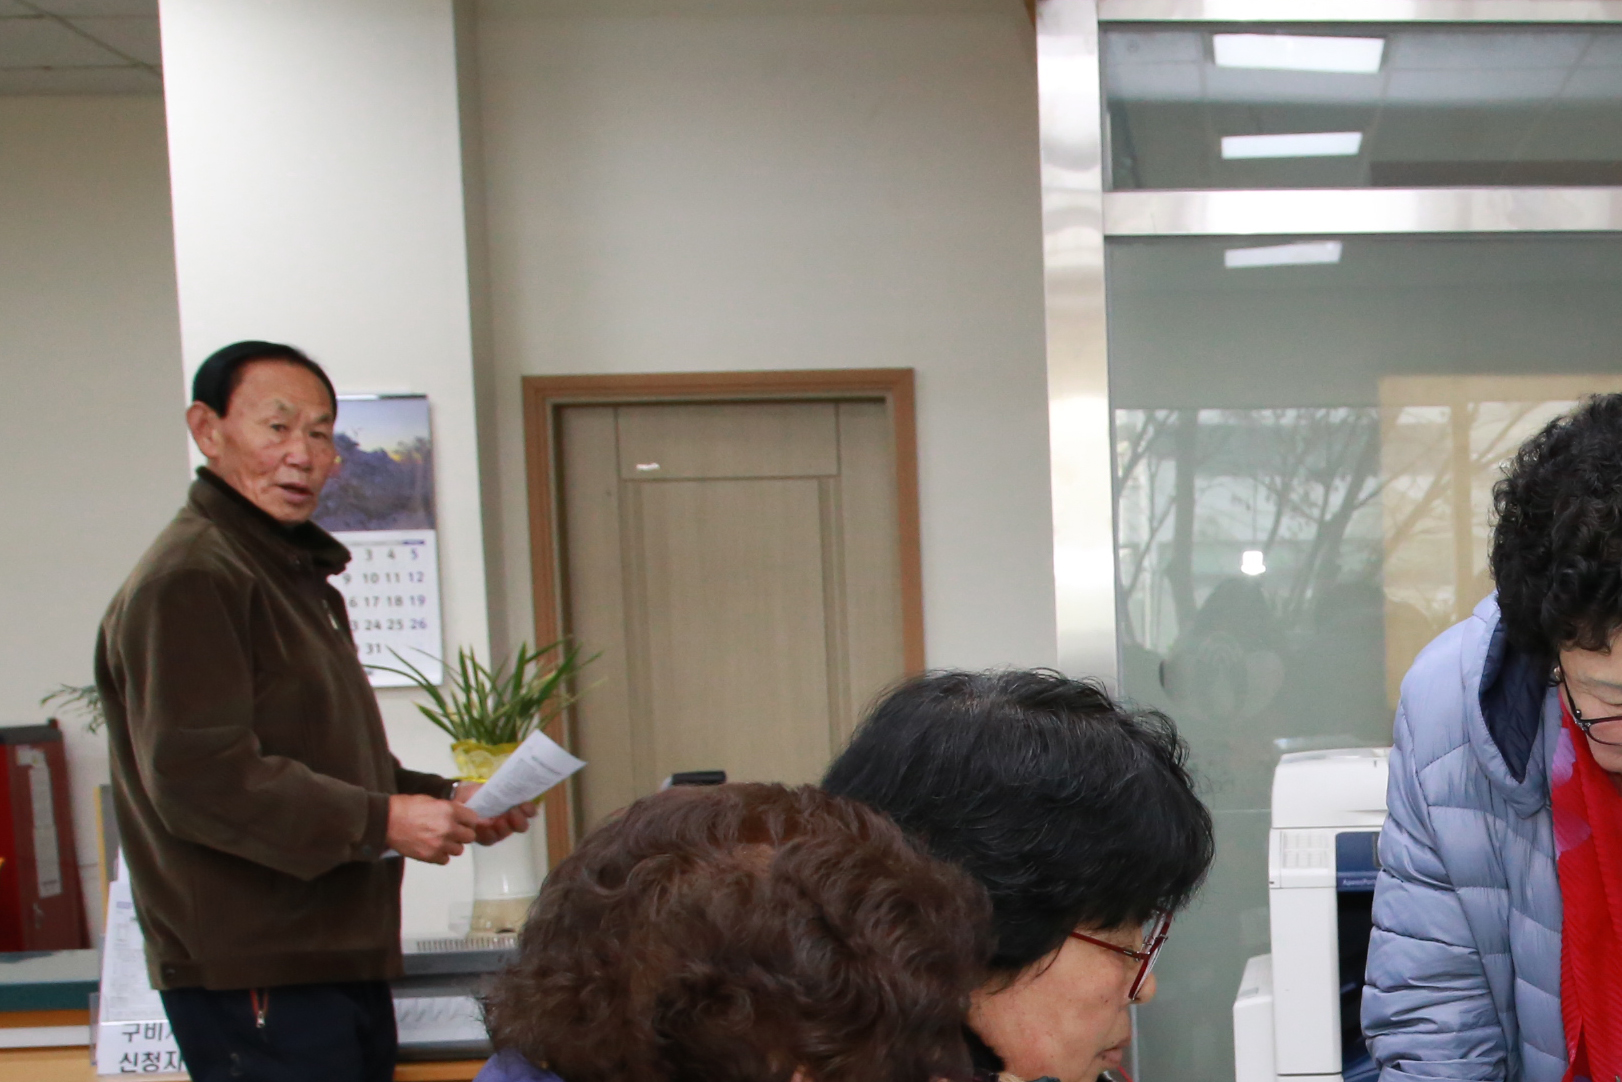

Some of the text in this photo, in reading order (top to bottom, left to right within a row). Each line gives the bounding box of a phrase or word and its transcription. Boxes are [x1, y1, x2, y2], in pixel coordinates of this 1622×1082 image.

[386, 549, 395, 560] 4
[411, 549, 419, 560] 5
[363, 573, 379, 584] 10
[385, 572, 400, 583] 11
[408, 571, 424, 583] 12
[364, 596, 379, 608] 17
[386, 596, 404, 607] 18
[409, 595, 426, 606] 19
[364, 619, 382, 631] 24
[386, 618, 404, 631] 25
[410, 618, 427, 630] 26
[366, 643, 382, 655] 31
[121, 1022, 174, 1044] 구비
